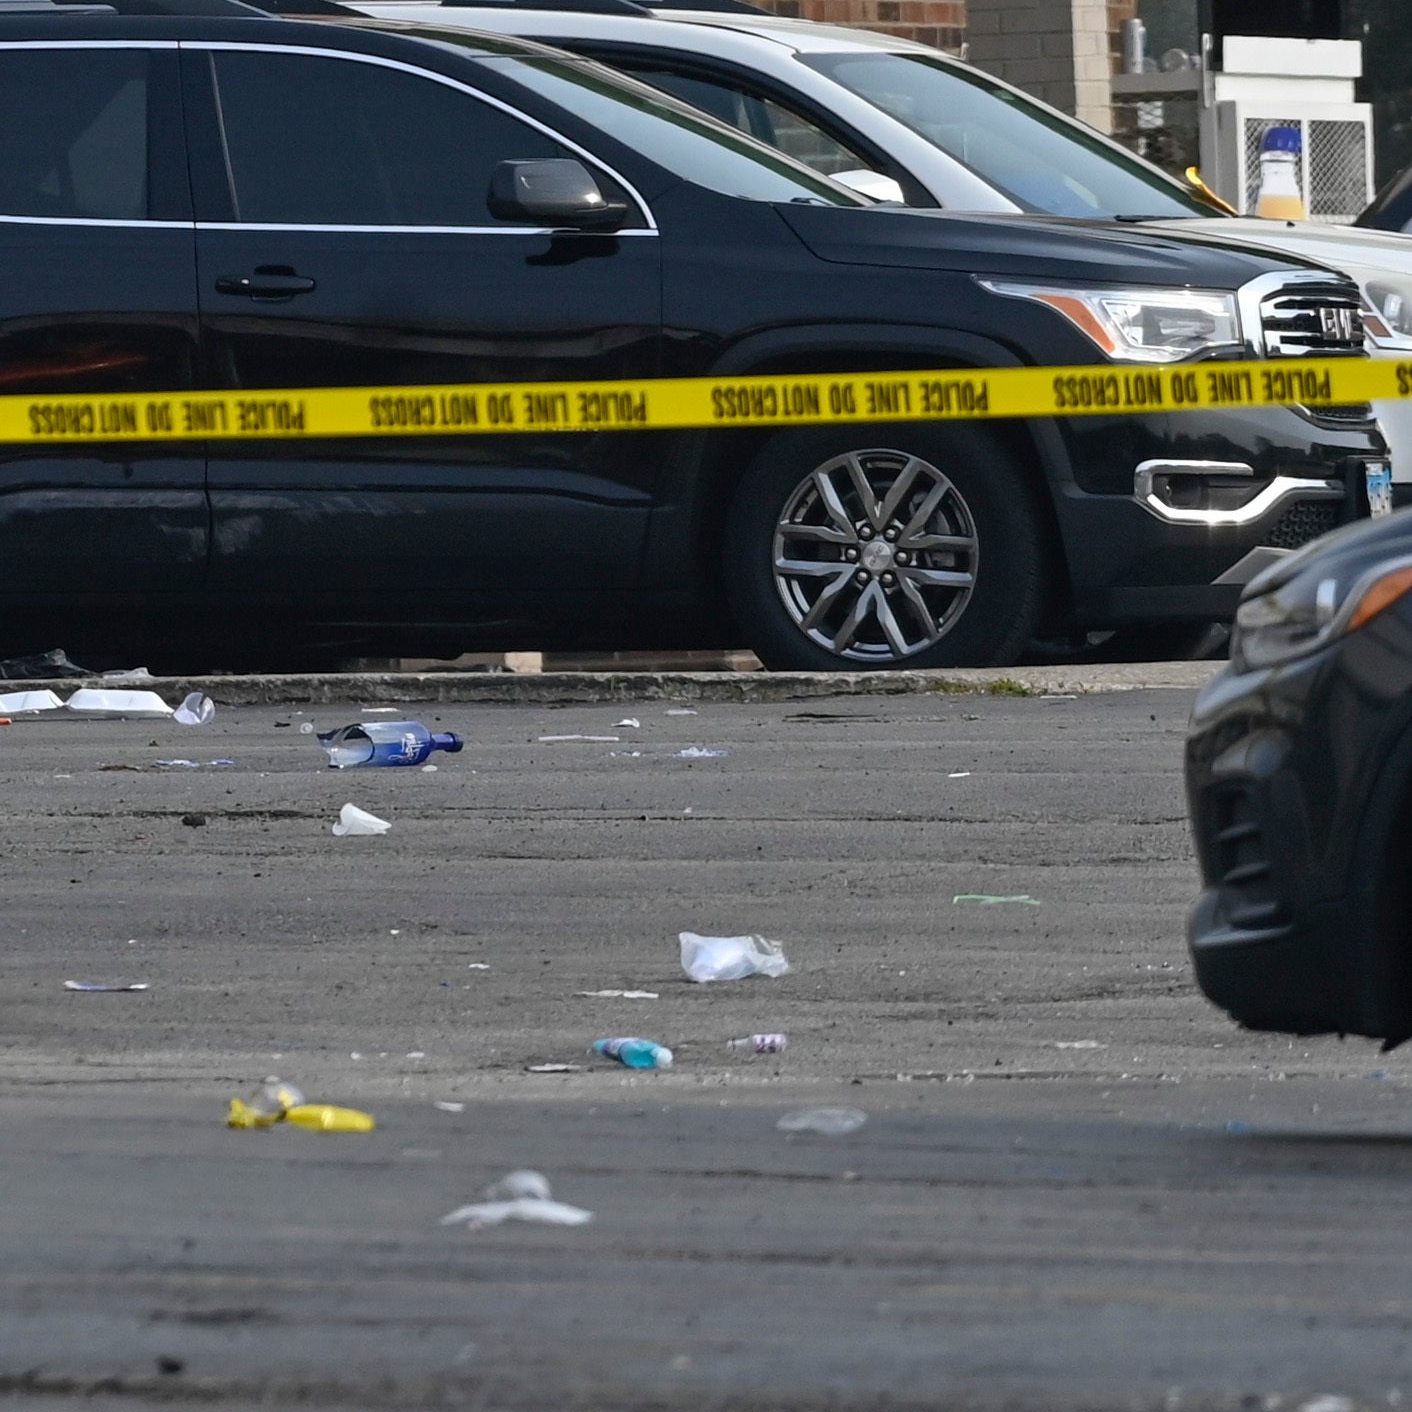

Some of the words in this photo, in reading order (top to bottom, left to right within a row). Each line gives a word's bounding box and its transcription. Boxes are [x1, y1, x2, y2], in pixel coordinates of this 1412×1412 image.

[709, 384, 778, 418] CROSS
[781, 383, 820, 416] NOT
[828, 382, 857, 415] DO
[863, 381, 911, 414] LINE
[917, 378, 990, 413] POLICE
[1052, 374, 1120, 408] CROSS
[1124, 372, 1163, 406] NOT
[1170, 371, 1198, 404] DO
[1205, 369, 1253, 403] LINE
[1261, 367, 1332, 402] POLICE
[27, 401, 95, 435] CROSS
[98, 401, 137, 434] NOT
[145, 400, 173, 433] DO
[180, 399, 229, 432] LINE
[236, 397, 306, 431] POLICE
[369, 395, 435, 428] CROSS
[439, 394, 477, 426] NOT
[486, 392, 514, 425] DO
[522, 391, 570, 425] LINE
[577, 390, 648, 424] POLICE
